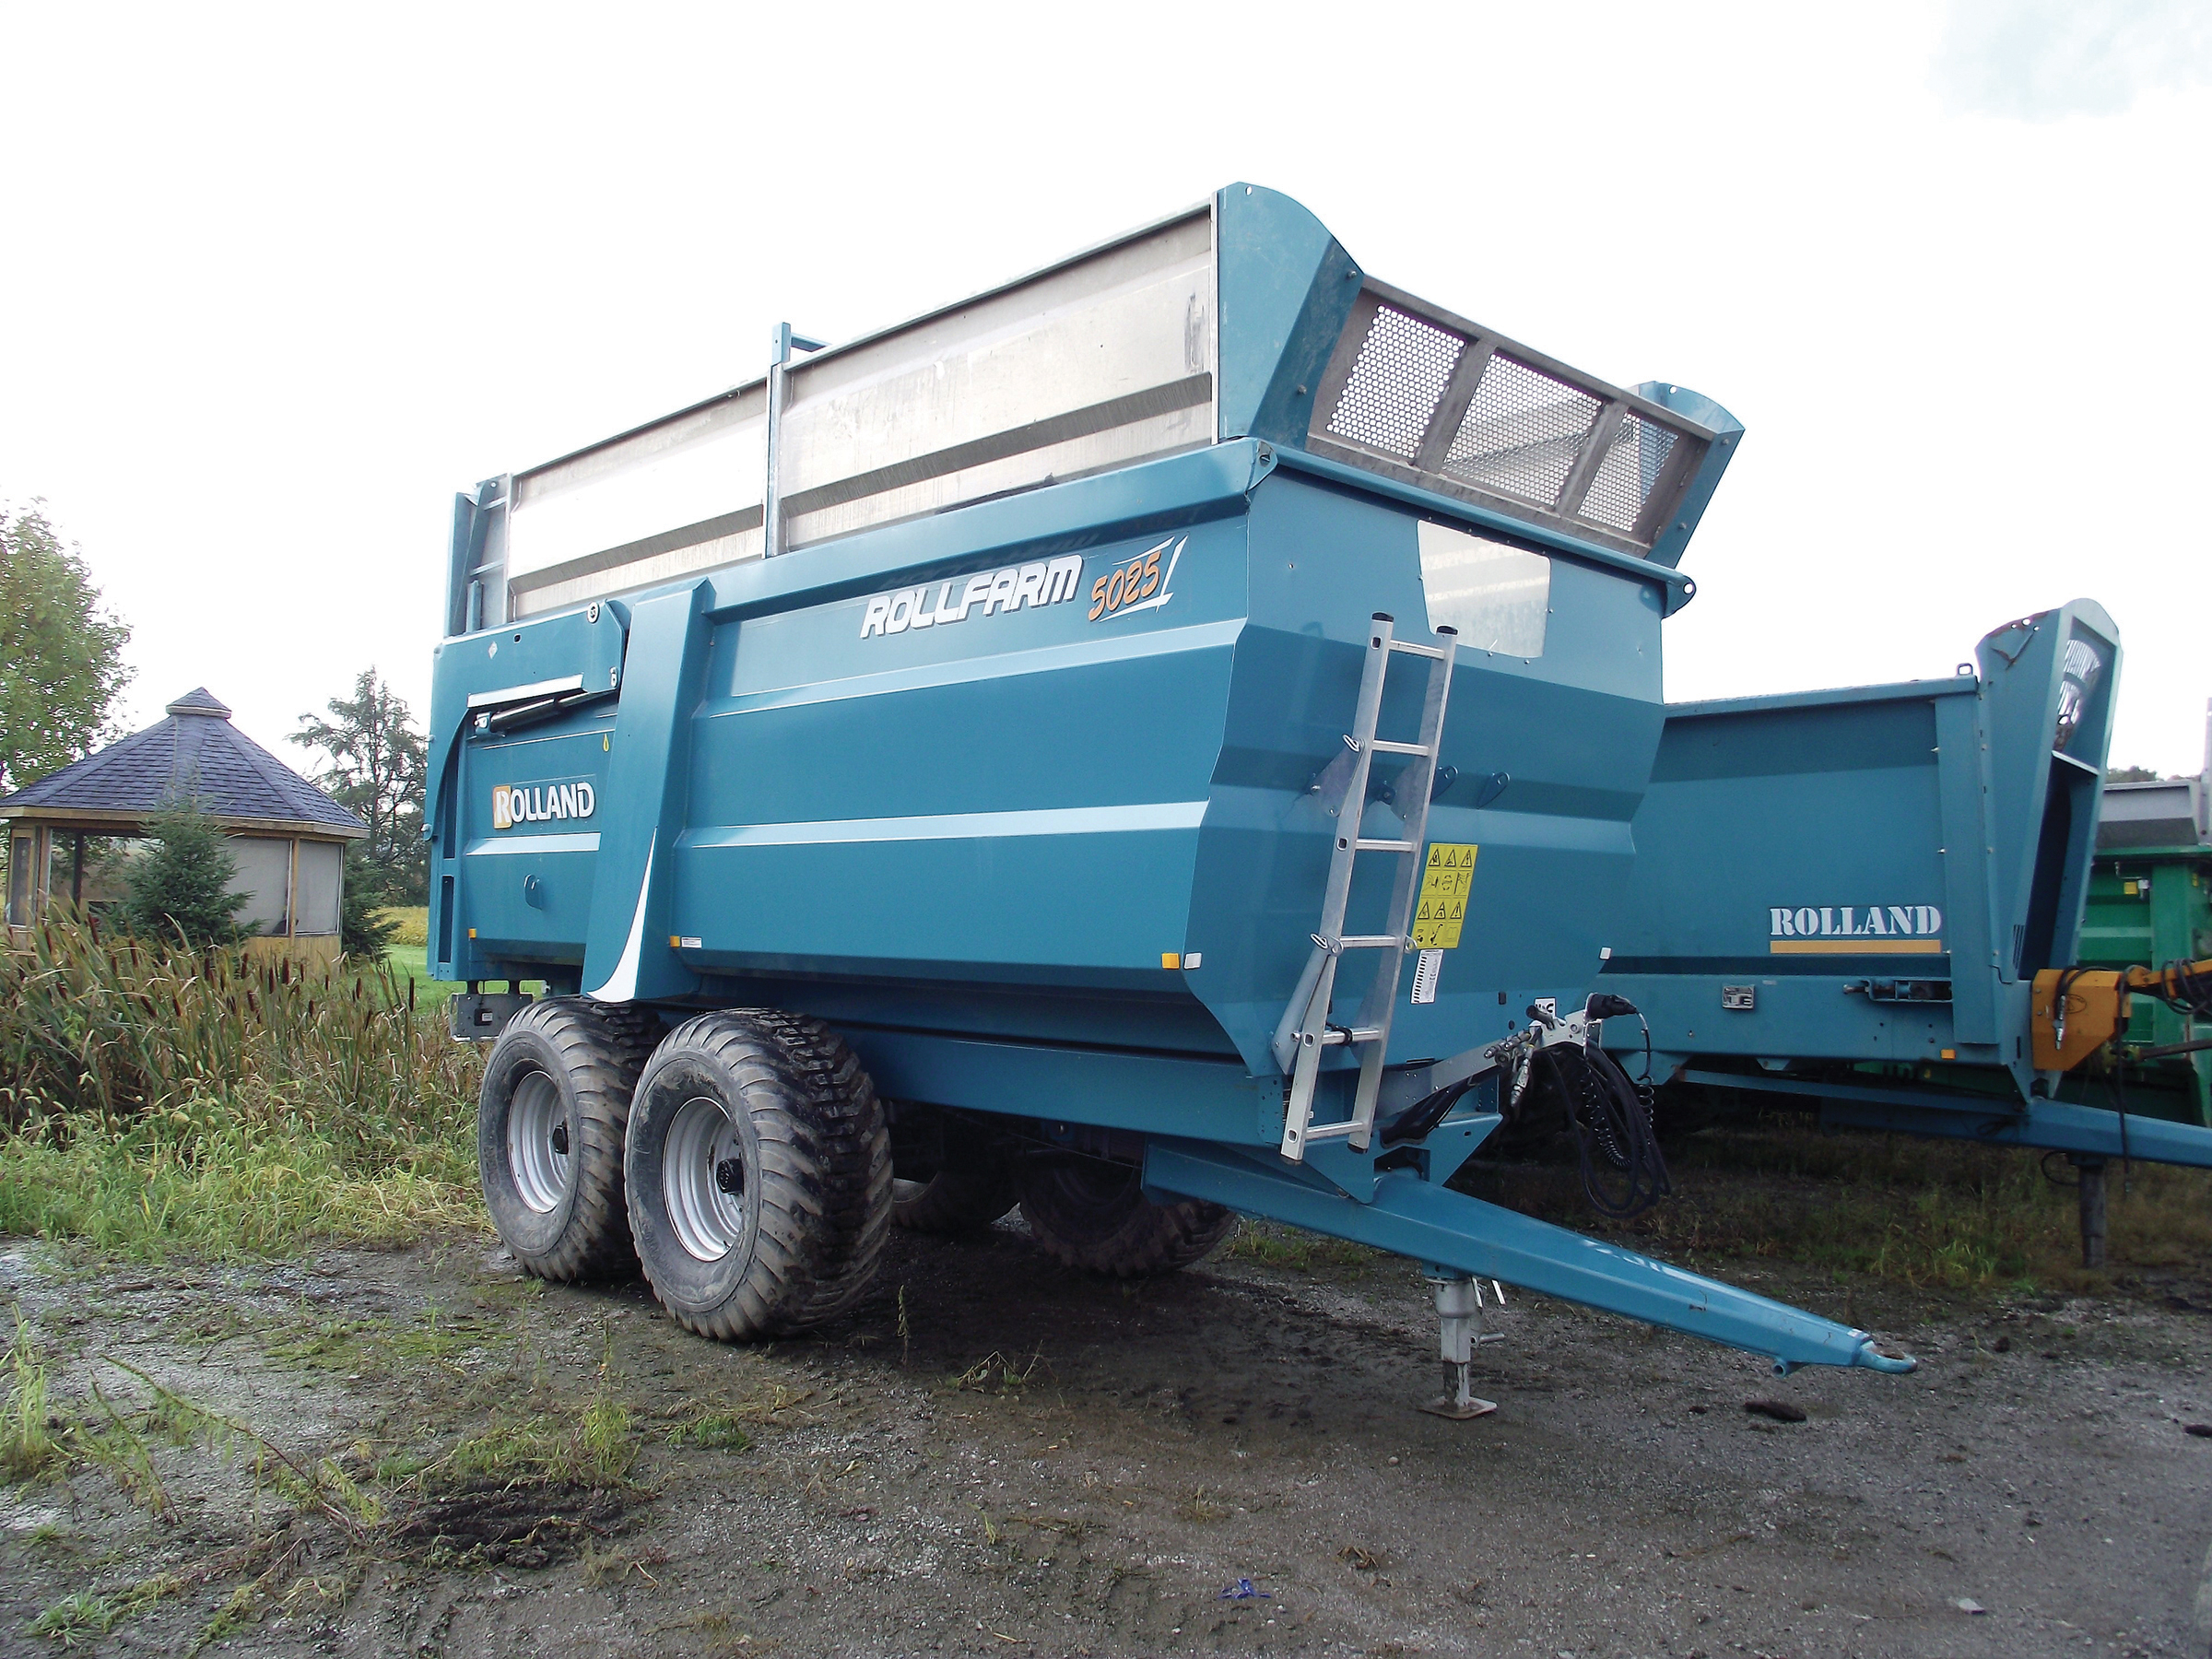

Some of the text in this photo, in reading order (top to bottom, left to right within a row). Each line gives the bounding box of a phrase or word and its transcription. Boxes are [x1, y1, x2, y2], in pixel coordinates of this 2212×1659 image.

[860, 550, 1161, 638] ROLLFARM 5025
[495, 782, 595, 823] ROLLAND
[1770, 905, 1941, 935] ROLLAND
